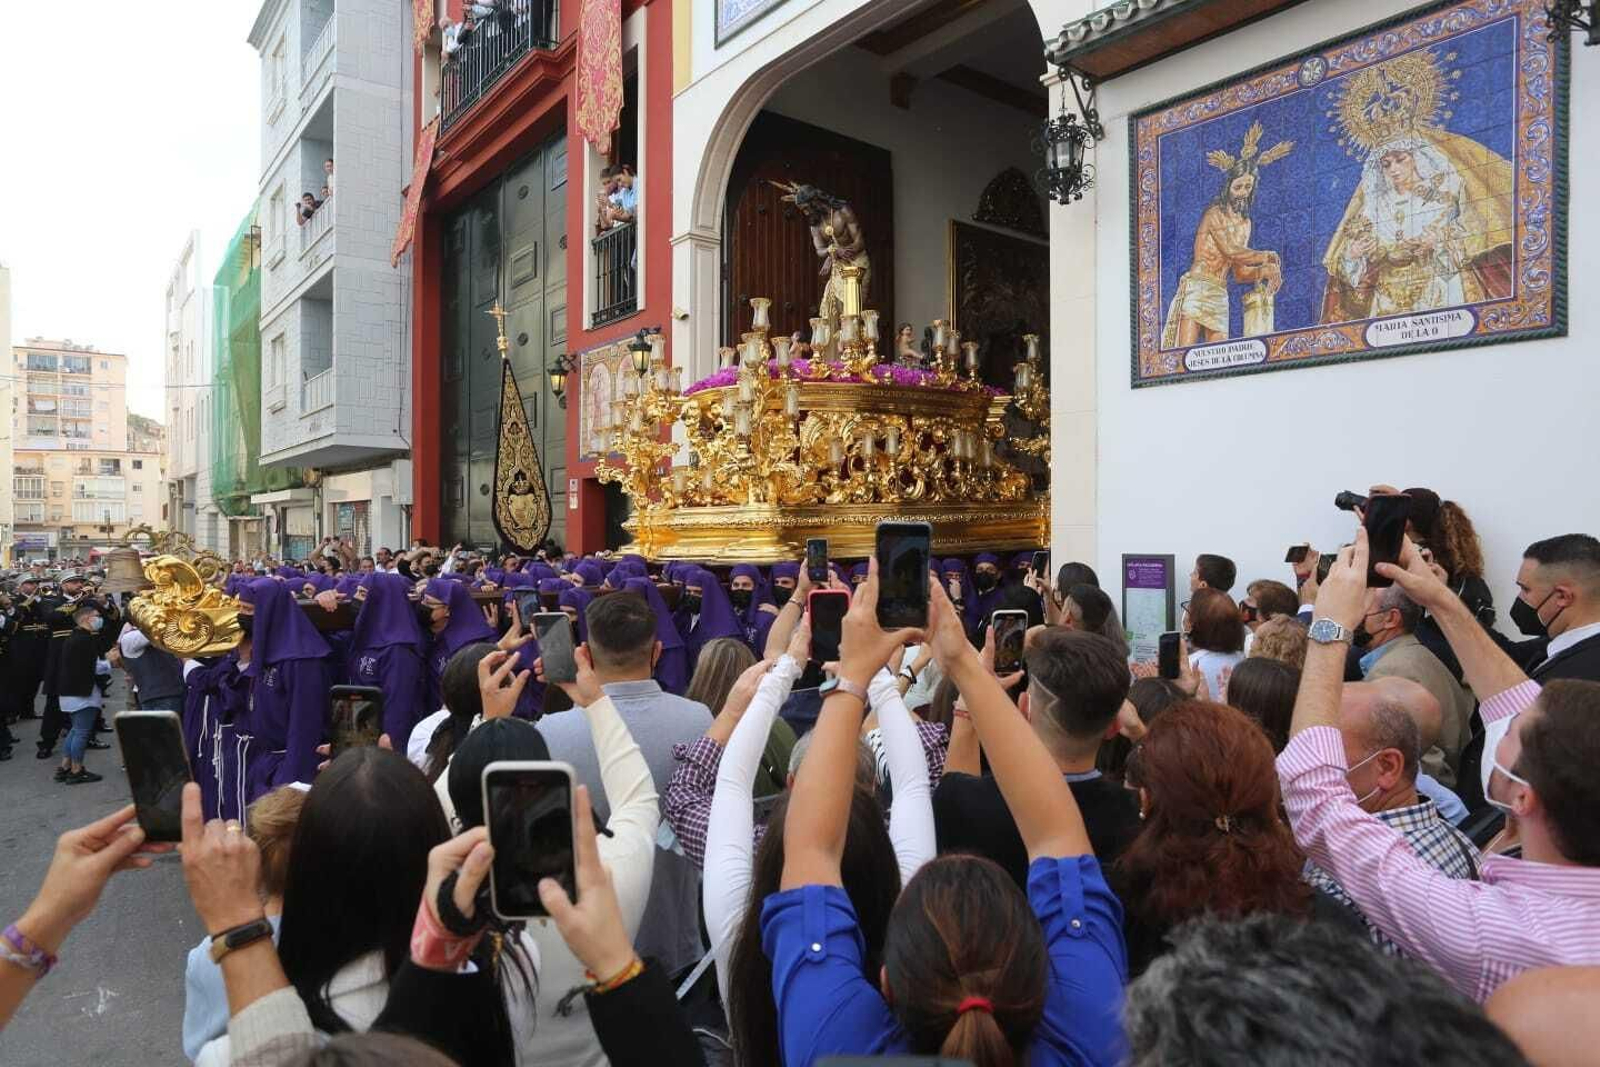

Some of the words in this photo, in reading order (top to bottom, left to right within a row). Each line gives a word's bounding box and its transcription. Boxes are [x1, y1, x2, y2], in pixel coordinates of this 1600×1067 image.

[1401, 331, 1411, 339] DE
[1416, 328, 1430, 338] LA
[1193, 346, 1227, 358] NUESTRO
